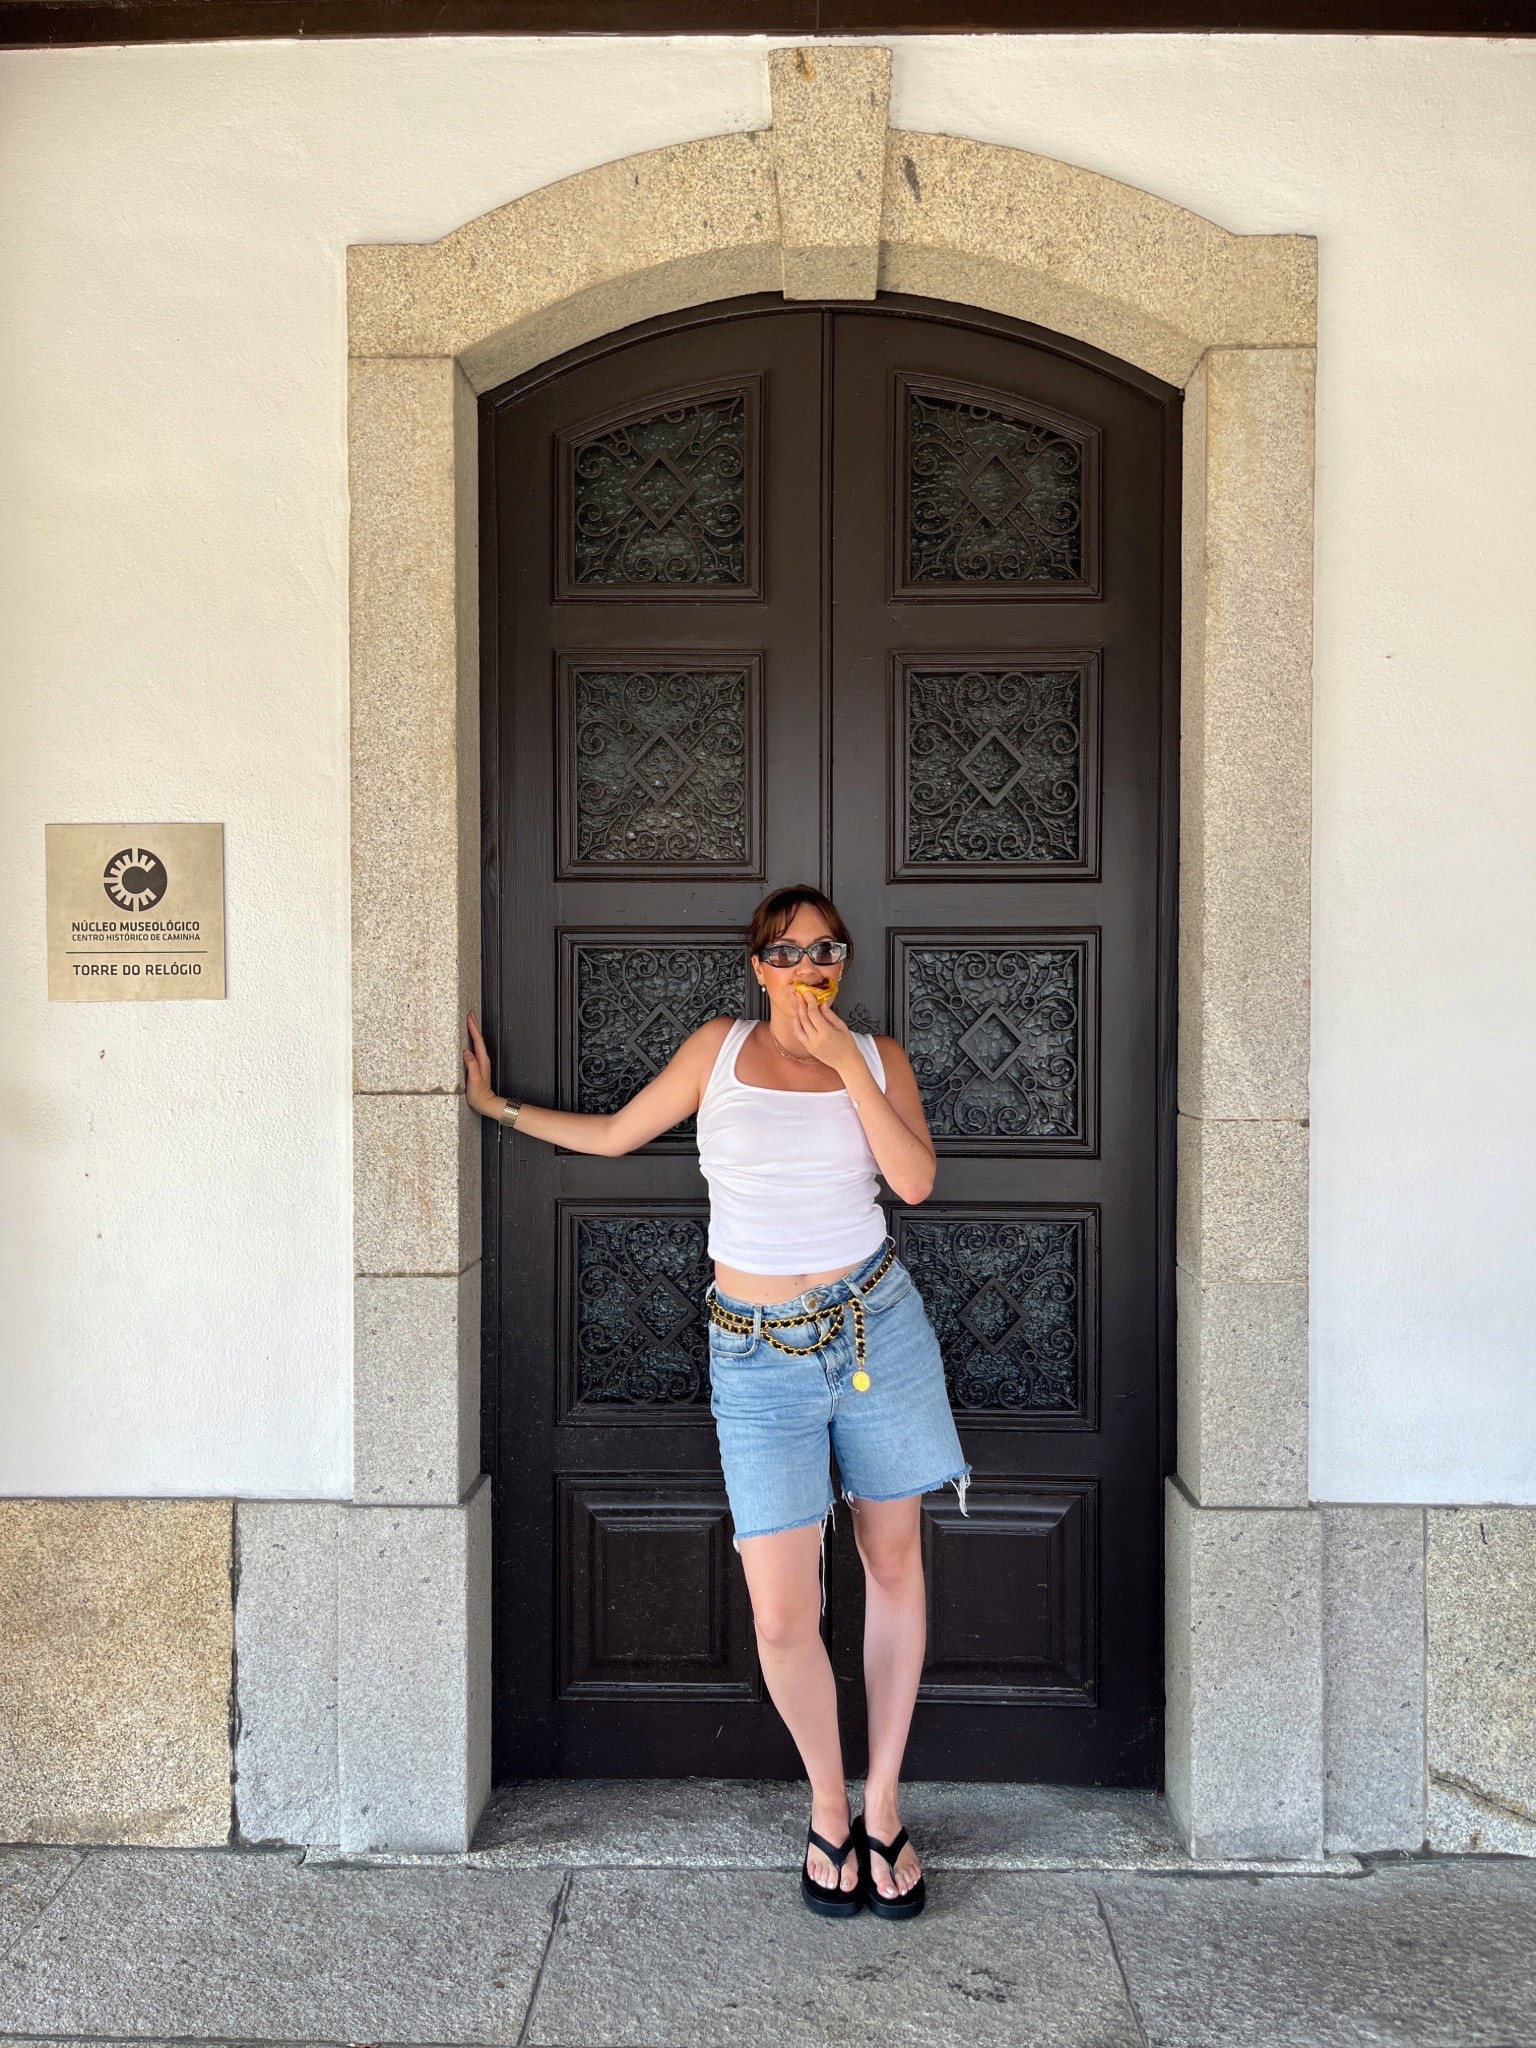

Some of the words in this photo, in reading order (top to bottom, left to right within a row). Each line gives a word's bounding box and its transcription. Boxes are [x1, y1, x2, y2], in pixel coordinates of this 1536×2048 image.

[71, 920, 117, 932] NÚCLEO
[119, 919, 200, 931] MUSEOLÓGICO
[106, 932, 149, 941] HISTÓRICO
[162, 933, 201, 941] CAMINHA
[73, 964, 118, 975] TORRE
[122, 964, 140, 975] DO
[145, 961, 202, 975] RELÓGIO
